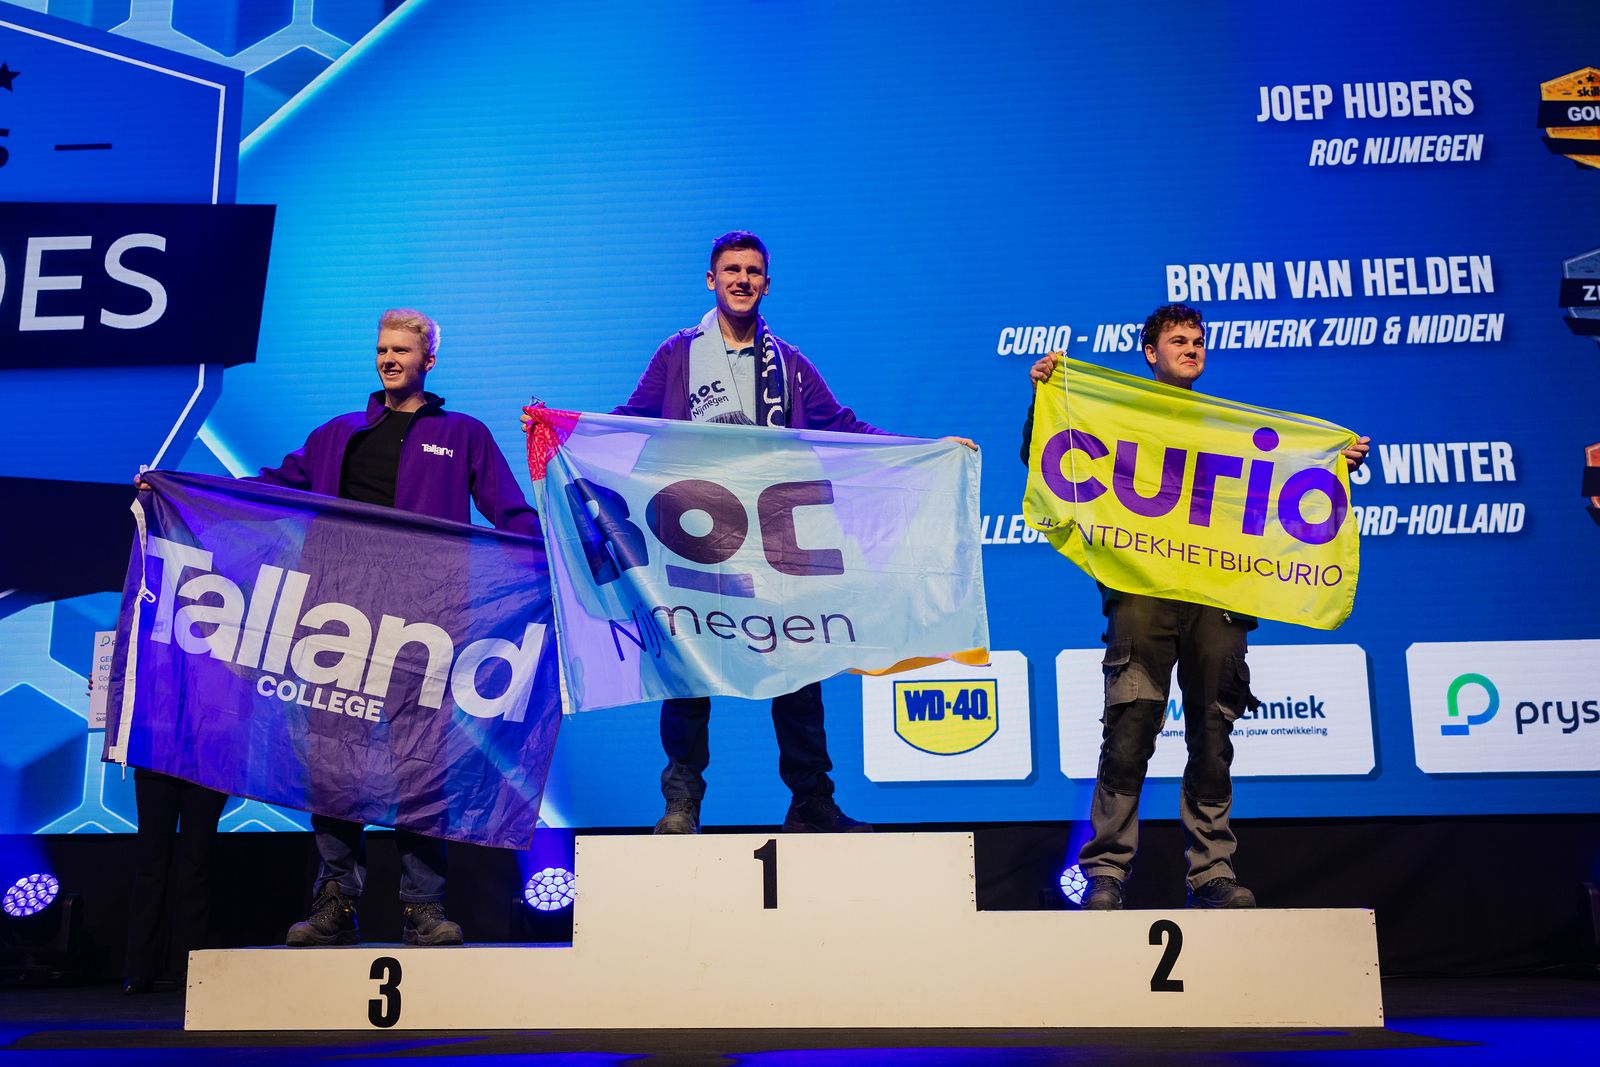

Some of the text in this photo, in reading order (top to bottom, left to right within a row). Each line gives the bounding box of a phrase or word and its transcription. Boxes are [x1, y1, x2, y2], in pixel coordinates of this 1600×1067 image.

[1257, 79, 1475, 122] JOEP HUBERS
[1308, 134, 1484, 166] ROC NIJMEGEN
[0, 233, 167, 333] ES
[1166, 255, 1495, 302] BRYAN VAN HELDEN
[997, 325, 1071, 355] CURIO
[1319, 317, 1377, 347] ZUID
[1383, 317, 1401, 344] &
[1407, 313, 1505, 344] MIDDEN
[689, 380, 725, 409] ROC
[692, 395, 728, 418] Nijmegen
[421, 443, 454, 458] Talland
[1378, 441, 1516, 484] WINTER
[1041, 427, 1347, 545] curio
[565, 477, 844, 587] ROC
[146, 534, 546, 723] Talland
[608, 601, 856, 662] Nijmegen
[256, 674, 384, 723] COLLEGE
[904, 688, 989, 721] WD-40
[1246, 727, 1268, 737] jouw
[1270, 726, 1328, 736] ontwikkeling
[753, 839, 777, 910] 1
[1149, 920, 1184, 993] 2
[368, 956, 402, 1028] 3
